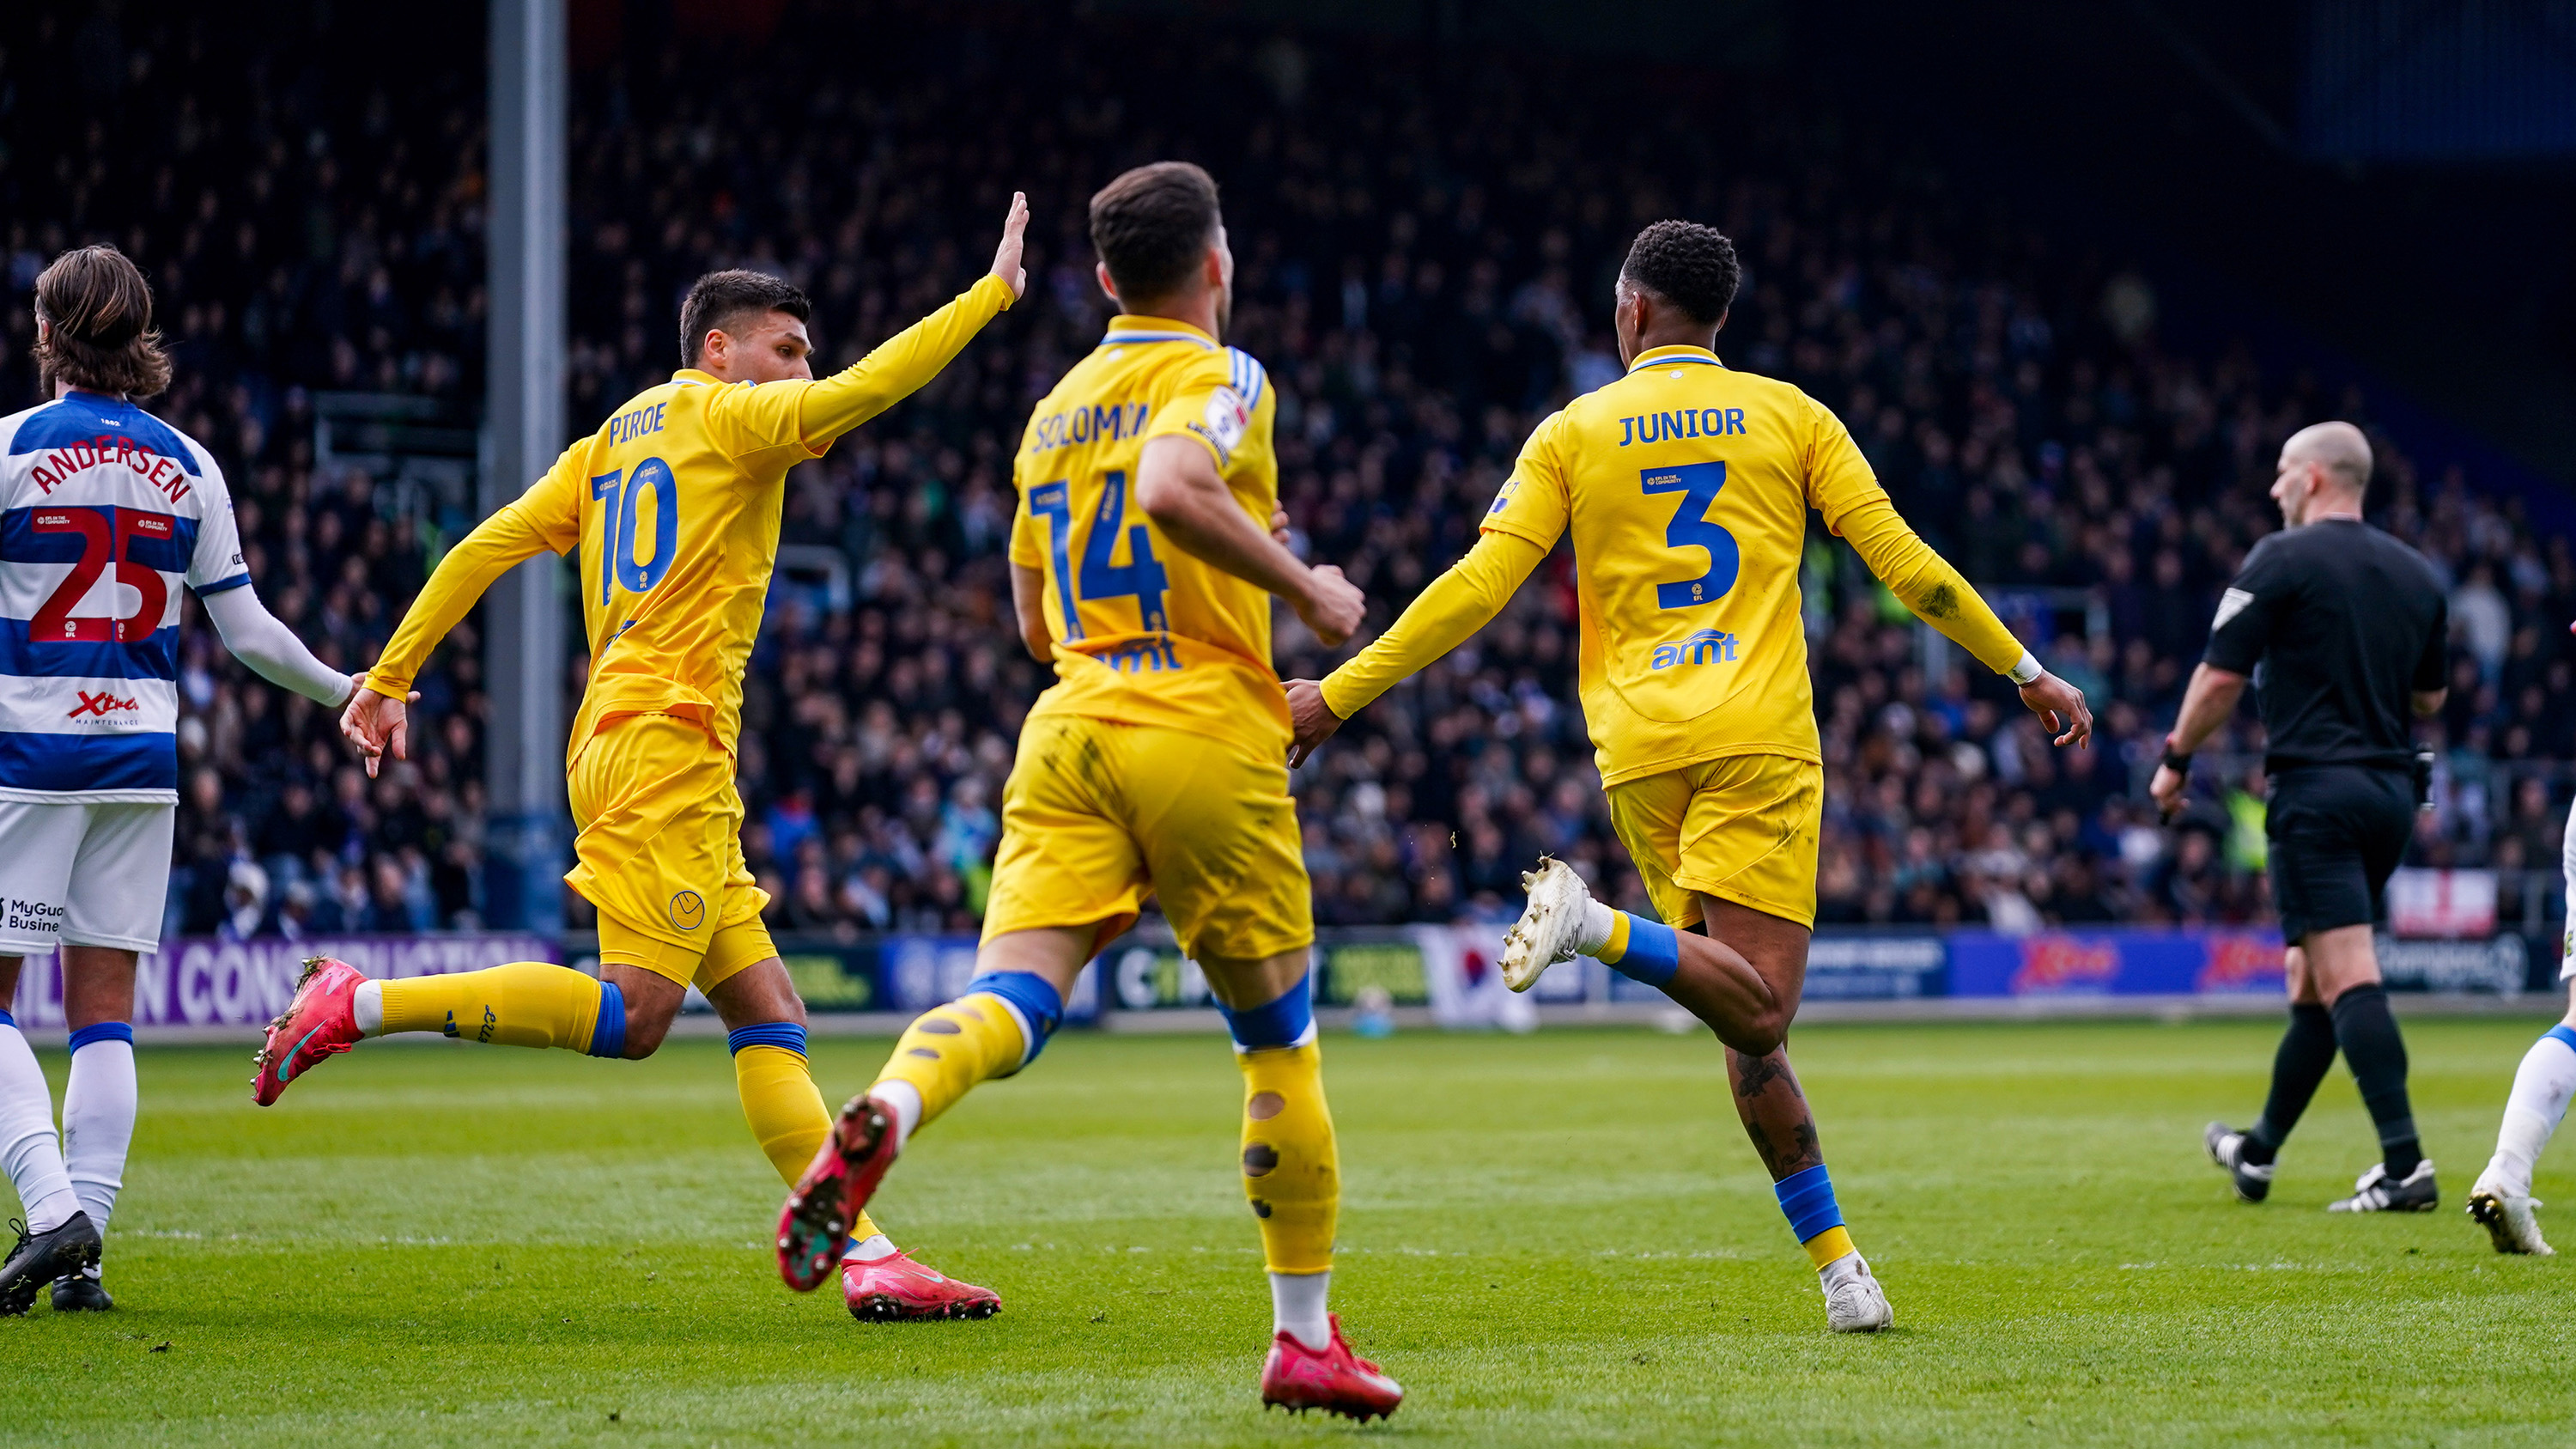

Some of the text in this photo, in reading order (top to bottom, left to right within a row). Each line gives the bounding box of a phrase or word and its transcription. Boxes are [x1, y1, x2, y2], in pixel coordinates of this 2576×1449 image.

[609, 401, 667, 447] PIROE
[1619, 408, 1747, 447] JUNIOR
[31, 435, 191, 505] ANDERSEN
[591, 456, 678, 606] 10
[1029, 470, 1170, 644] 14
[1639, 460, 1740, 610] 3
[29, 506, 175, 642] 25
[1651, 631, 1740, 670] amt
[68, 691, 139, 718] Xtra
